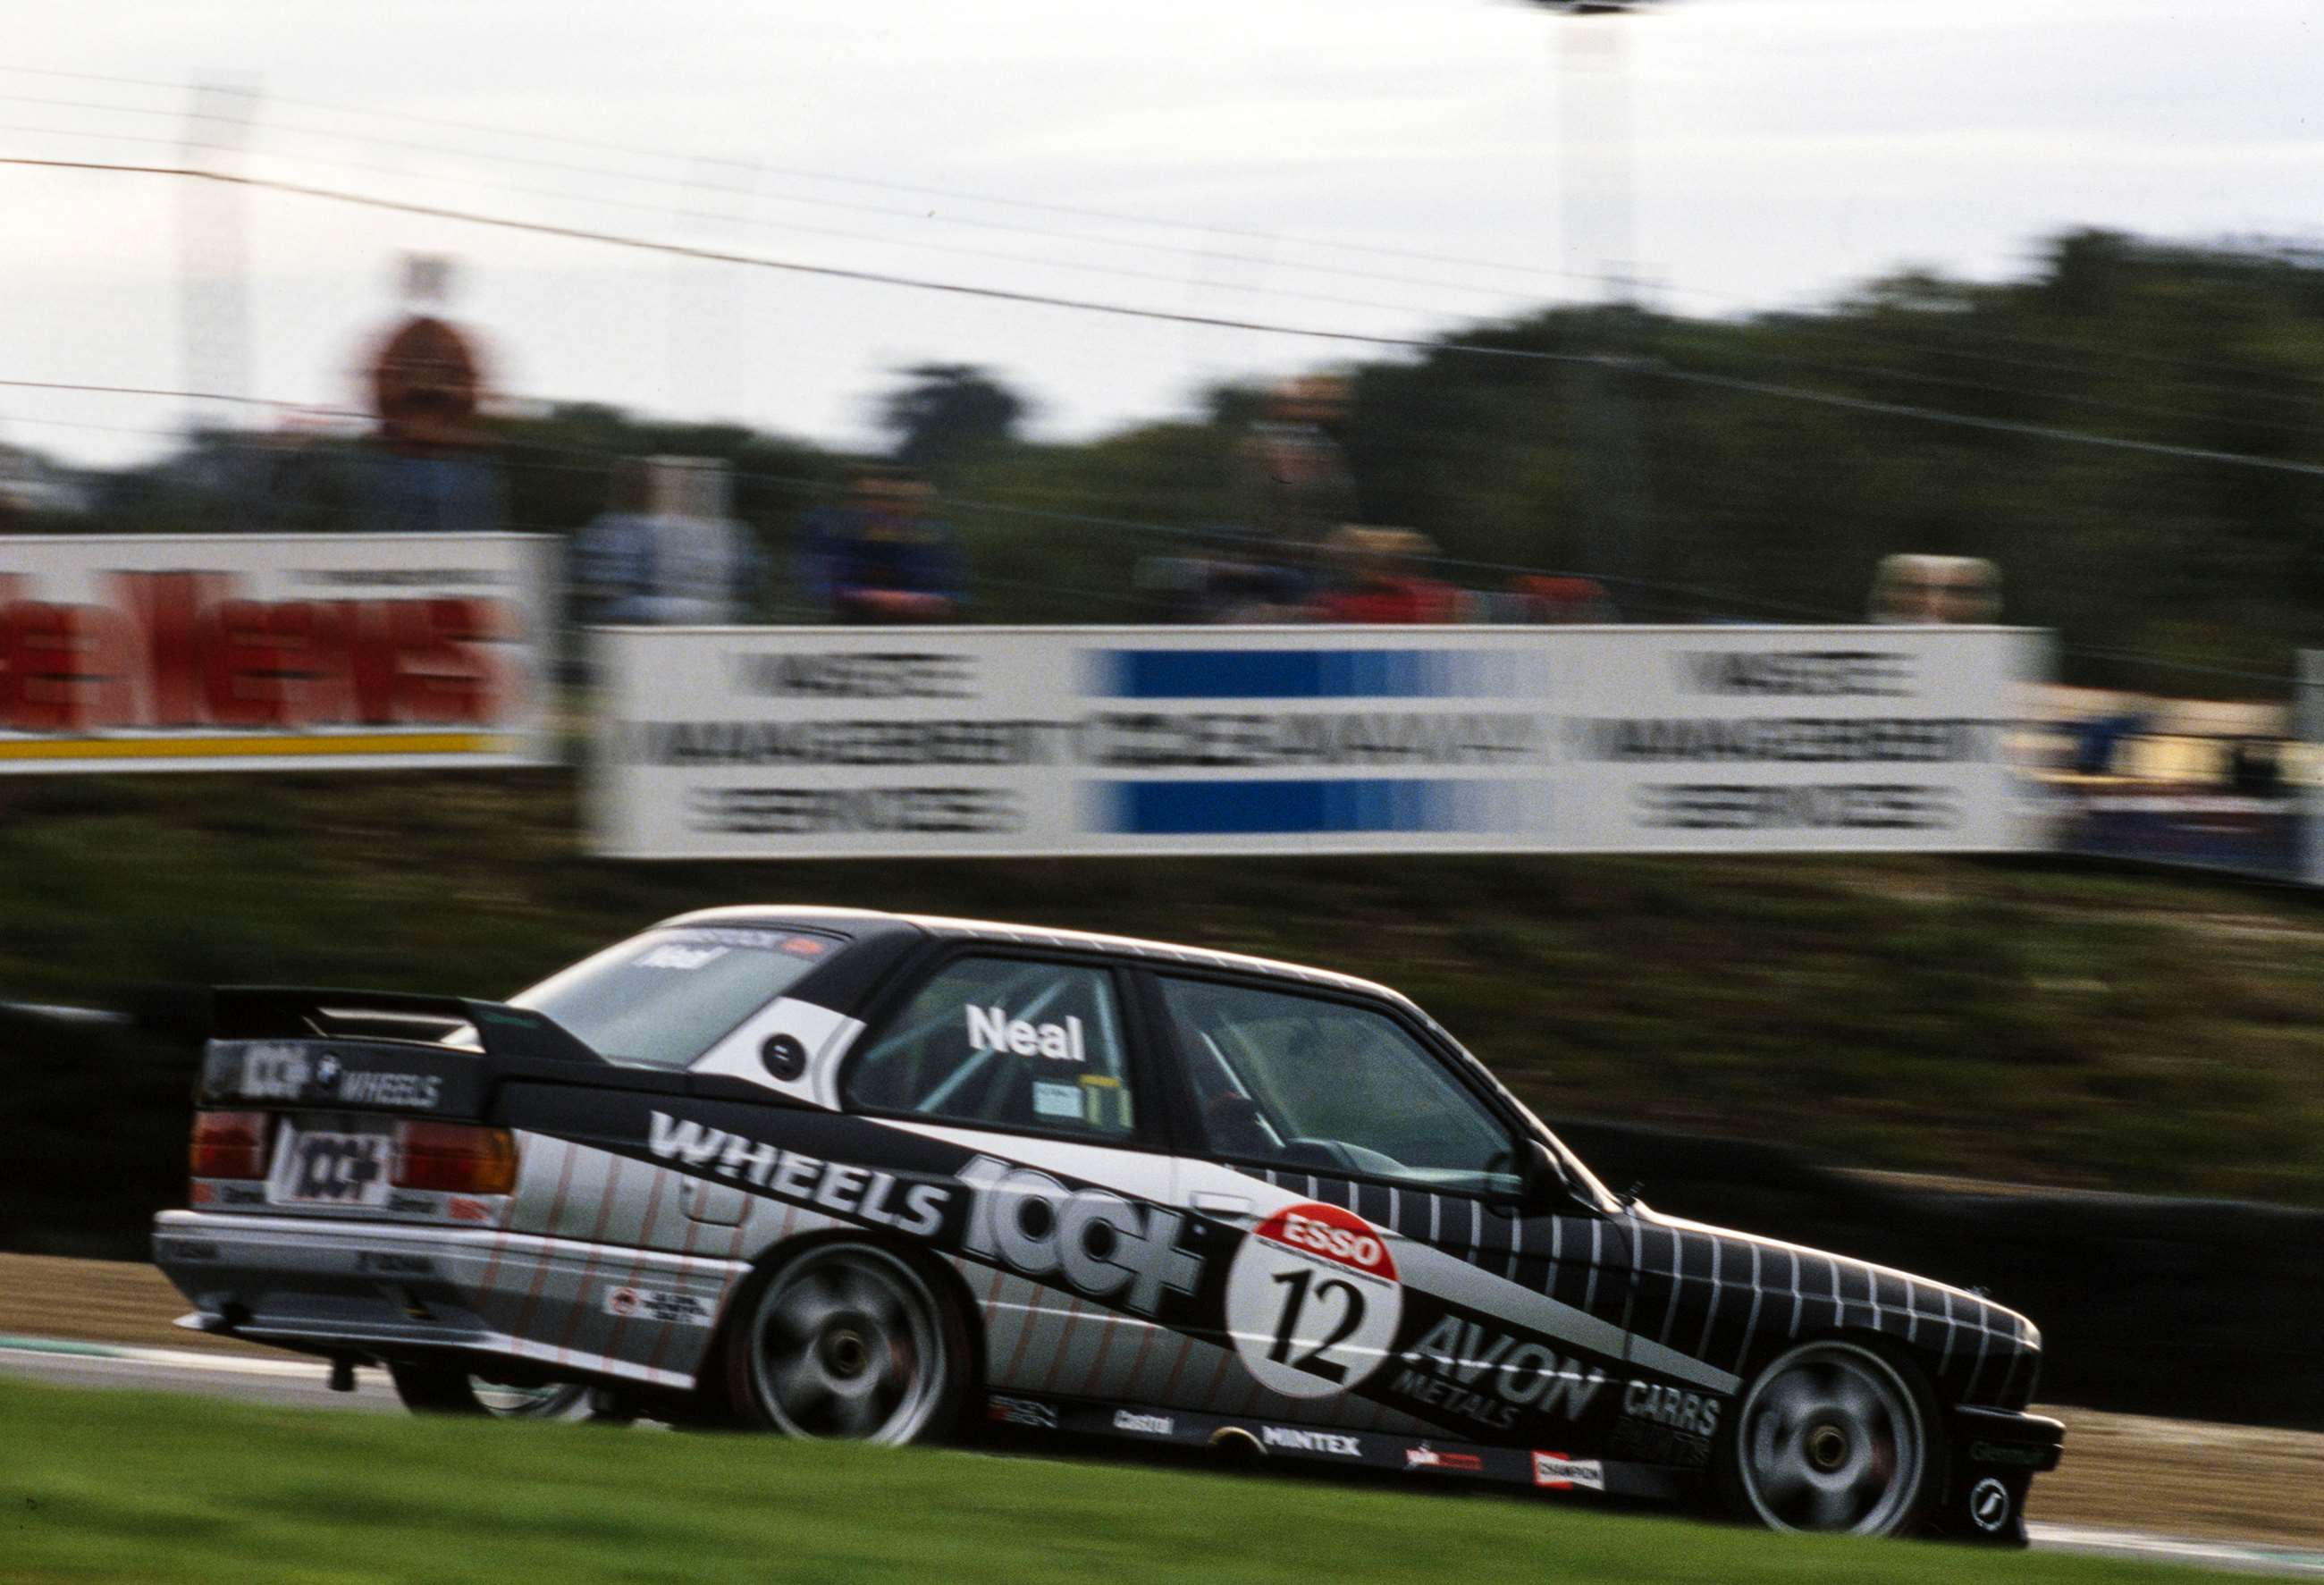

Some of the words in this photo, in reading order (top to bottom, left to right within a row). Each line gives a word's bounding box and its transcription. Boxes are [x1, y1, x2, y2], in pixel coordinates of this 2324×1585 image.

[965, 1003, 1086, 1062] Neal
[649, 1110, 952, 1236] WHEELS
[1284, 1212, 1382, 1268] ESSO
[1272, 1268, 1368, 1387] 12
[1403, 1312, 1607, 1423] AVON
[1387, 1368, 1521, 1430] METALS
[1623, 1379, 1722, 1439] CARRS
[1261, 1425, 1363, 1457] MINTEX
